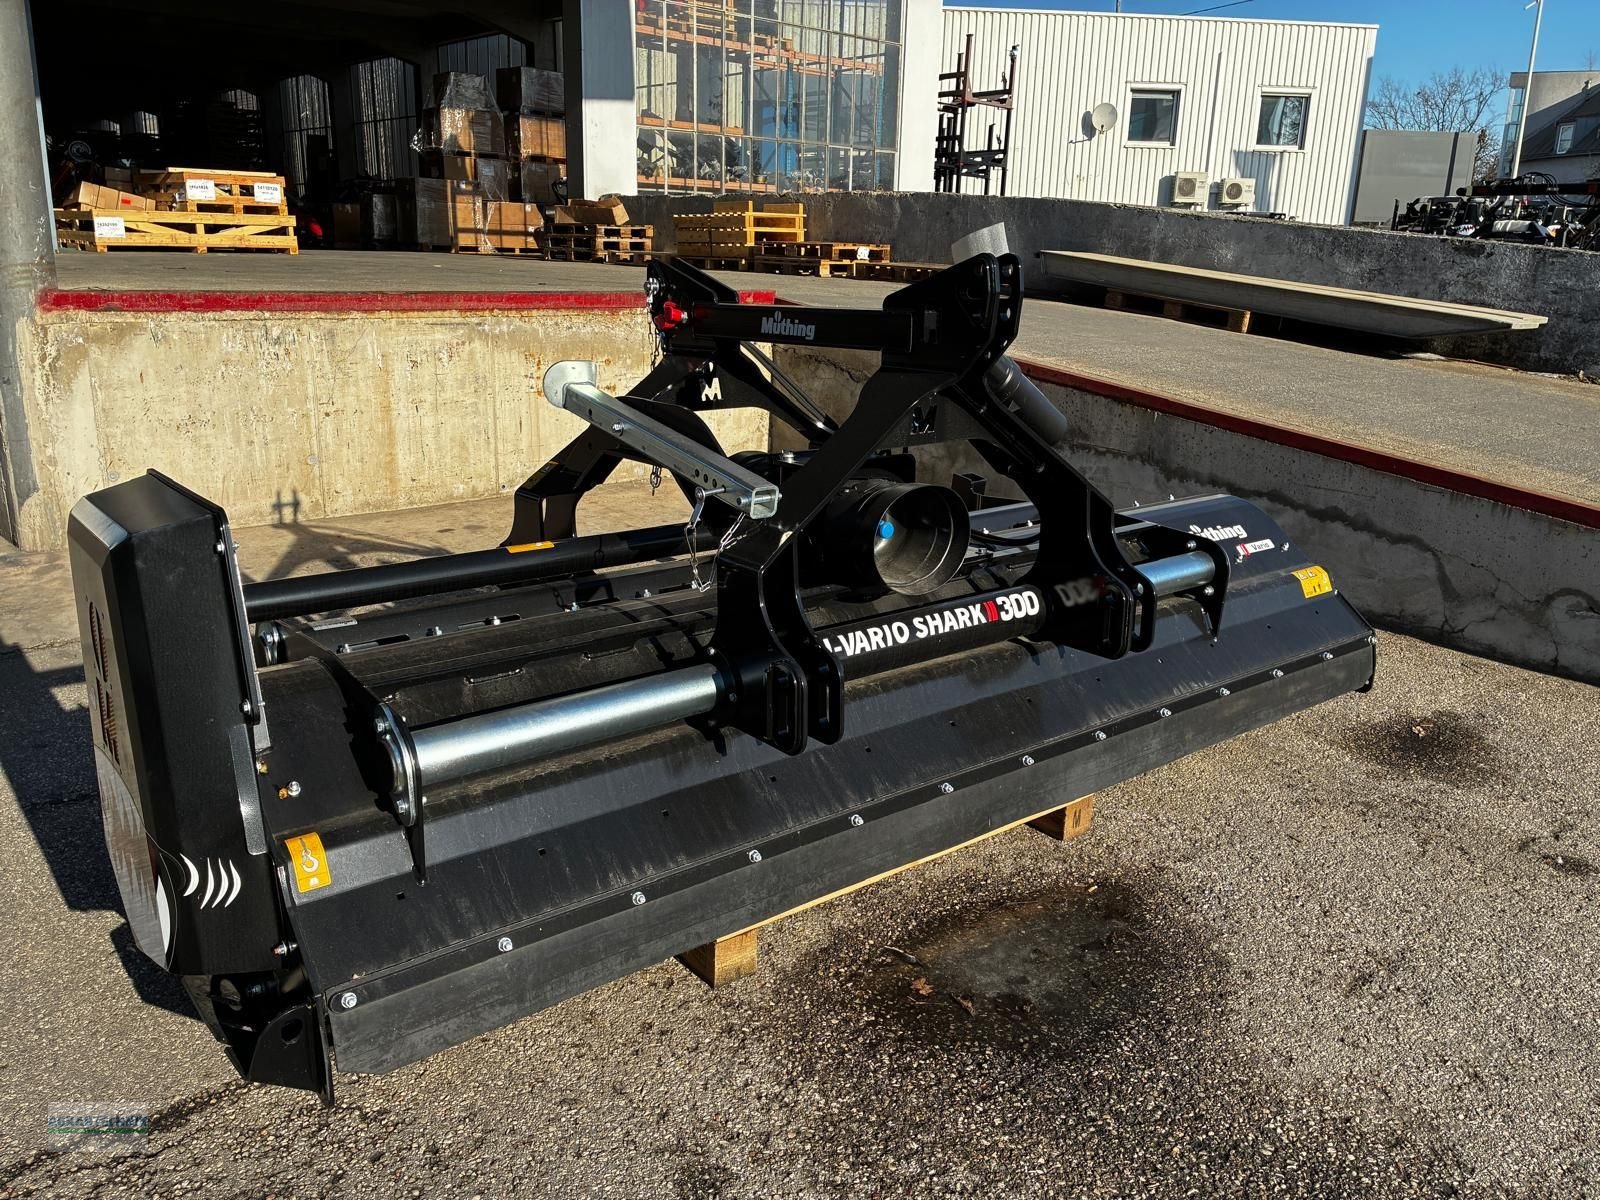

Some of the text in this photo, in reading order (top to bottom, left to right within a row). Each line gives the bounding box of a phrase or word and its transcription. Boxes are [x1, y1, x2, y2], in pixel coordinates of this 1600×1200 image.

[1188, 524, 1248, 542] thing
[1251, 542, 1270, 551] Vario
[912, 603, 988, 639] SHARK
[995, 590, 1040, 622] 300
